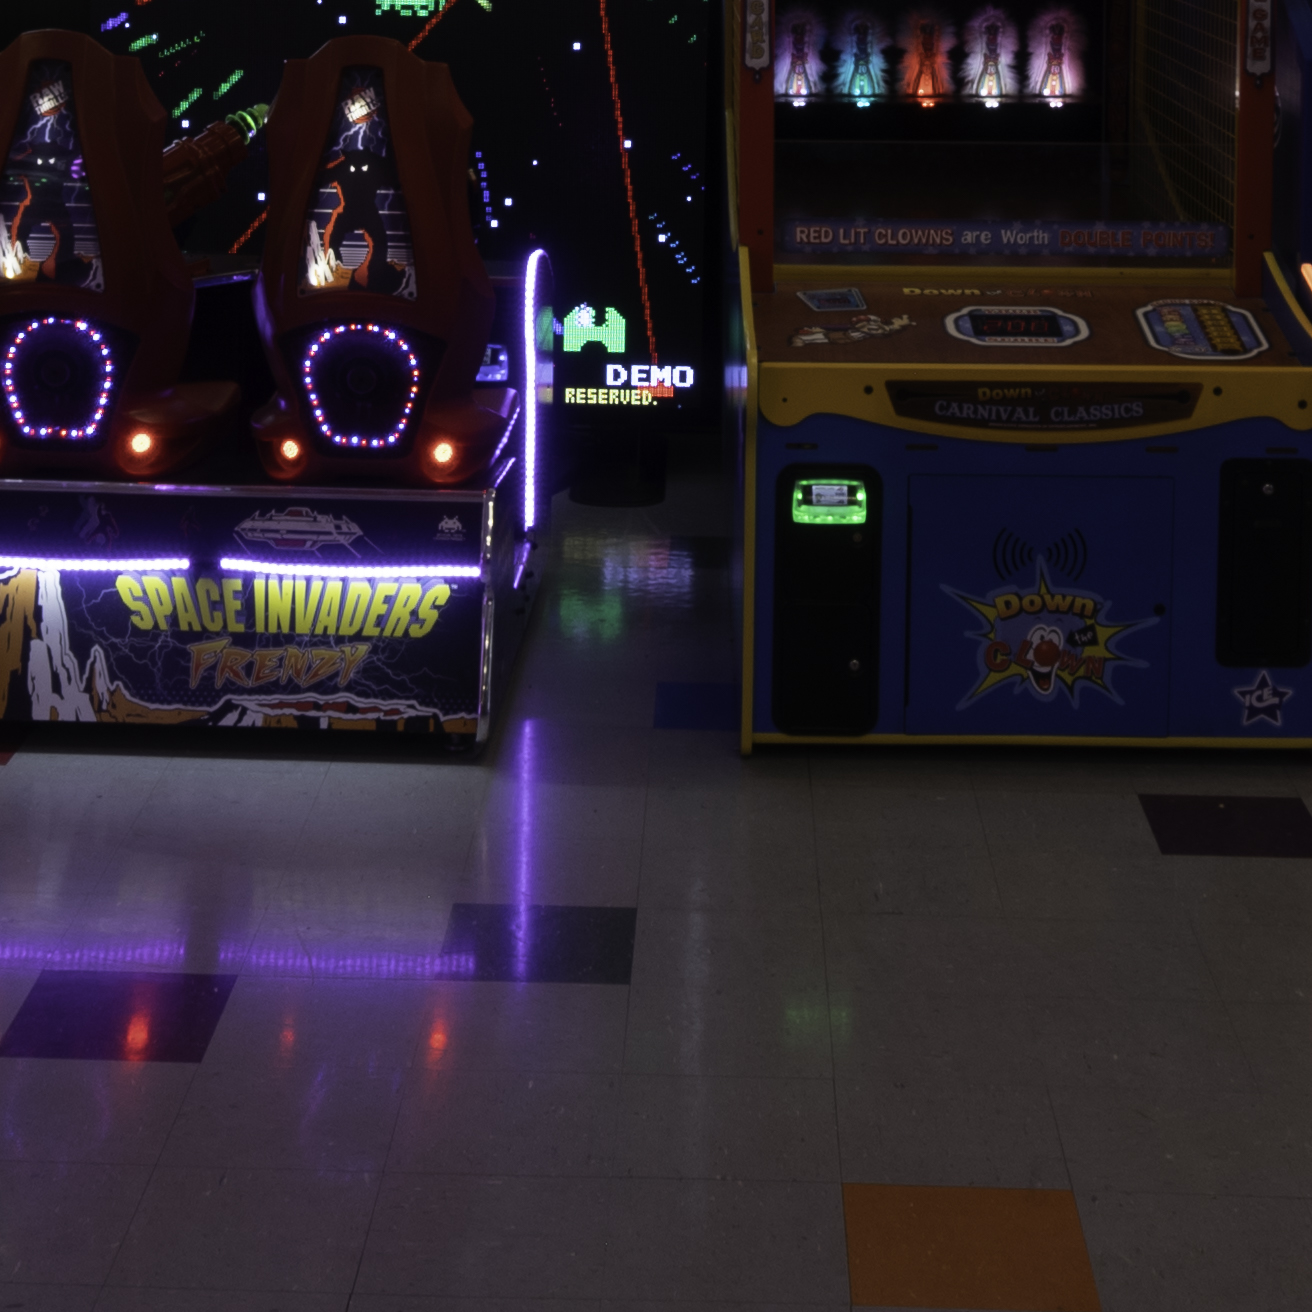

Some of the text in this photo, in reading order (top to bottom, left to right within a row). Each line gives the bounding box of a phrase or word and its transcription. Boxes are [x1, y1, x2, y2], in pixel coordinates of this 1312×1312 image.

[1250, 8, 1269, 61] GAME
[29, 79, 64, 108] RAW
[795, 225, 1217, 250] RED LIT CLOWNS are Worth DOUBLE POINTS!
[902, 287, 983, 296] Down
[606, 364, 694, 388] DEMO
[564, 388, 658, 406] RESERVED.
[977, 387, 1032, 402] Down
[934, 400, 1145, 422] CARNIVAL CLASSICS
[115, 574, 451, 638] SPACE INVADERS
[993, 593, 1096, 620] Down
[1074, 630, 1094, 645] the
[188, 637, 372, 689] FRENZY
[1245, 687, 1281, 708] ICE
